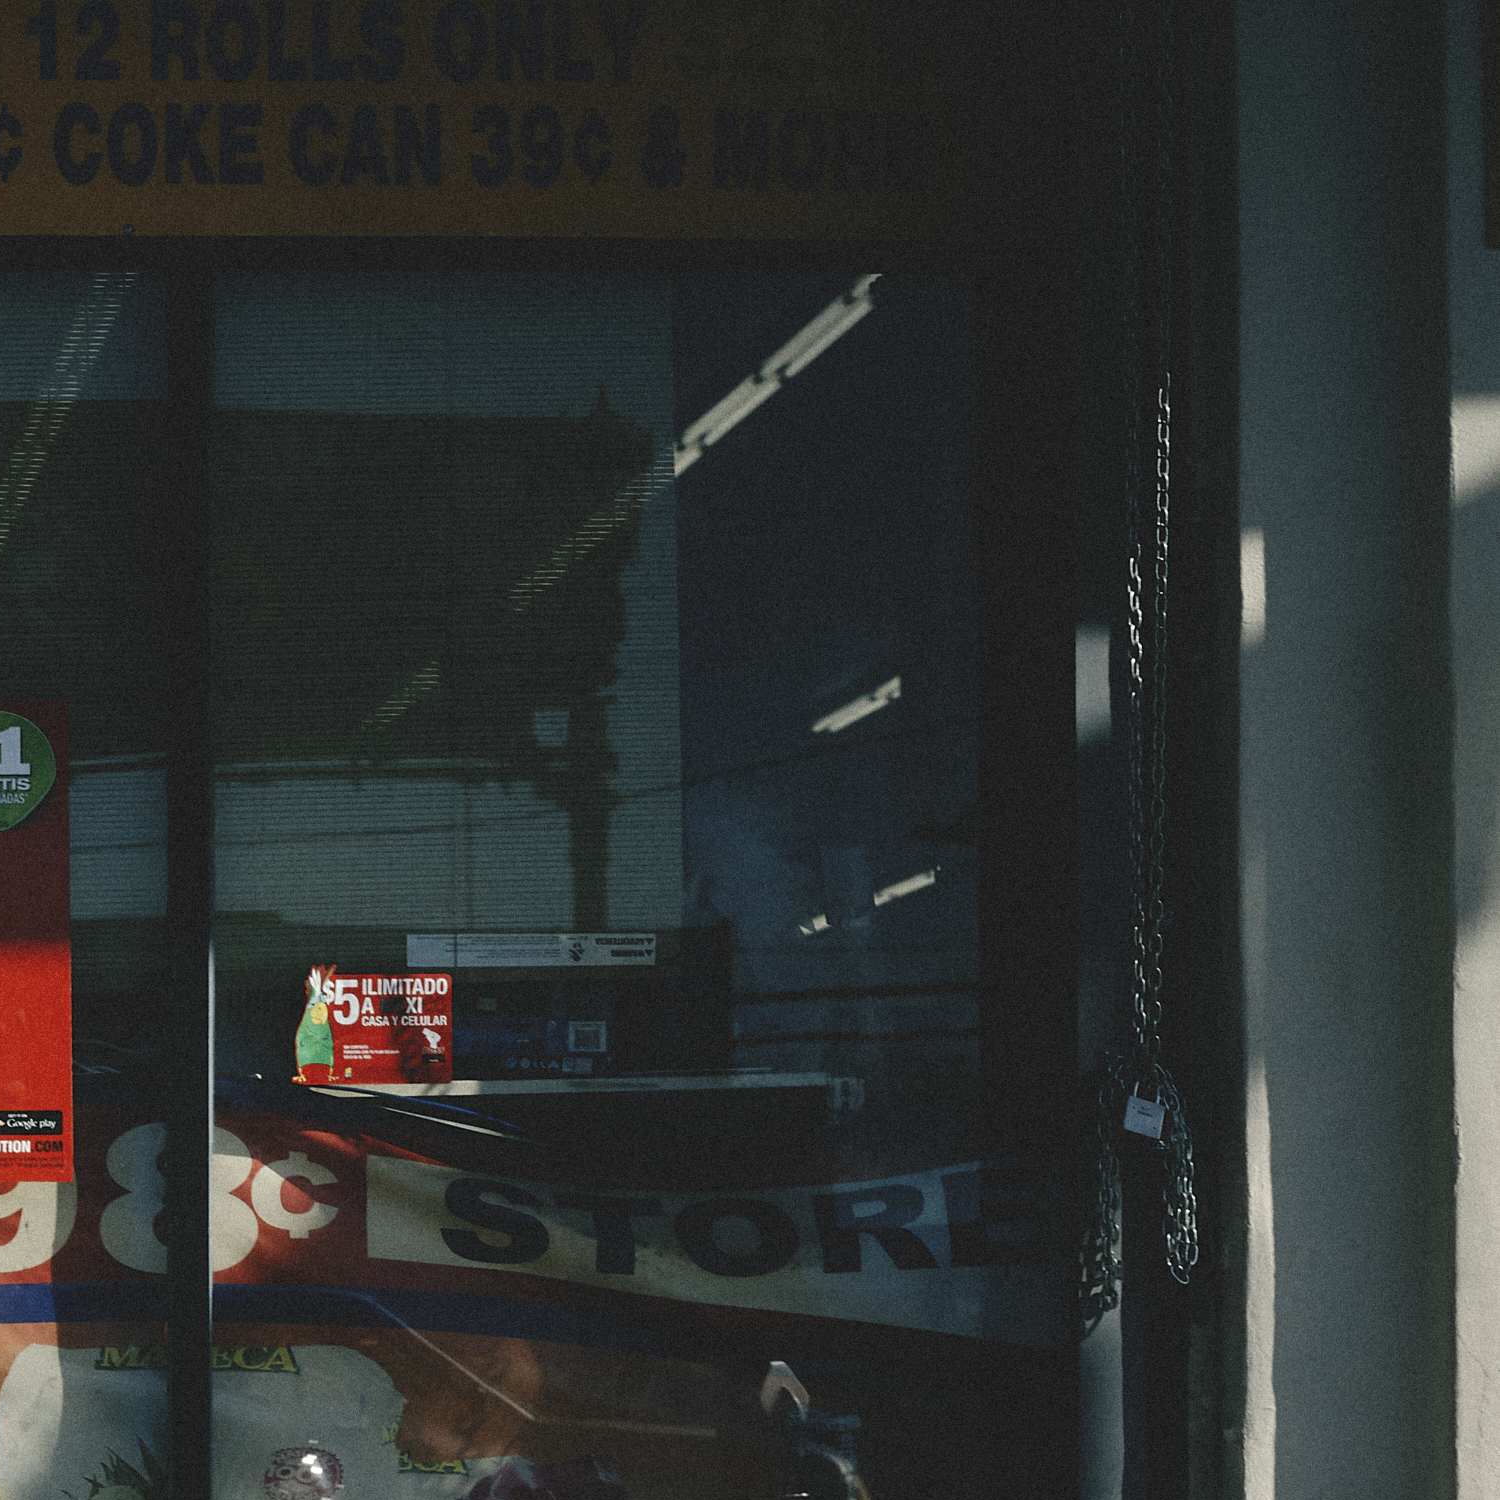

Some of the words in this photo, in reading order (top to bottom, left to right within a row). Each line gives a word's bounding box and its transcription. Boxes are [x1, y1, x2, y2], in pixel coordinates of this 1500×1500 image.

[26, 0, 121, 83] 12
[151, 0, 407, 84] ROLLS
[434, 0, 647, 84] ONLY
[54, 102, 264, 188] COKE
[290, 102, 443, 188] CAN
[471, 104, 613, 189] 39¢
[641, 105, 686, 188] &
[714, 106, 931, 192] MORE
[361, 977, 449, 996] ILIMITADO
[322, 978, 361, 1026] $5
[361, 996, 375, 1014] A
[361, 1015, 390, 1027] CASA
[391, 1015, 398, 1026] Y
[400, 1015, 448, 1026] CELULAR
[6, 1118, 37, 1131] Google
[39, 1119, 57, 1131] play
[441, 1168, 1049, 1279] STORE
[100, 1346, 296, 1372] MAECA
